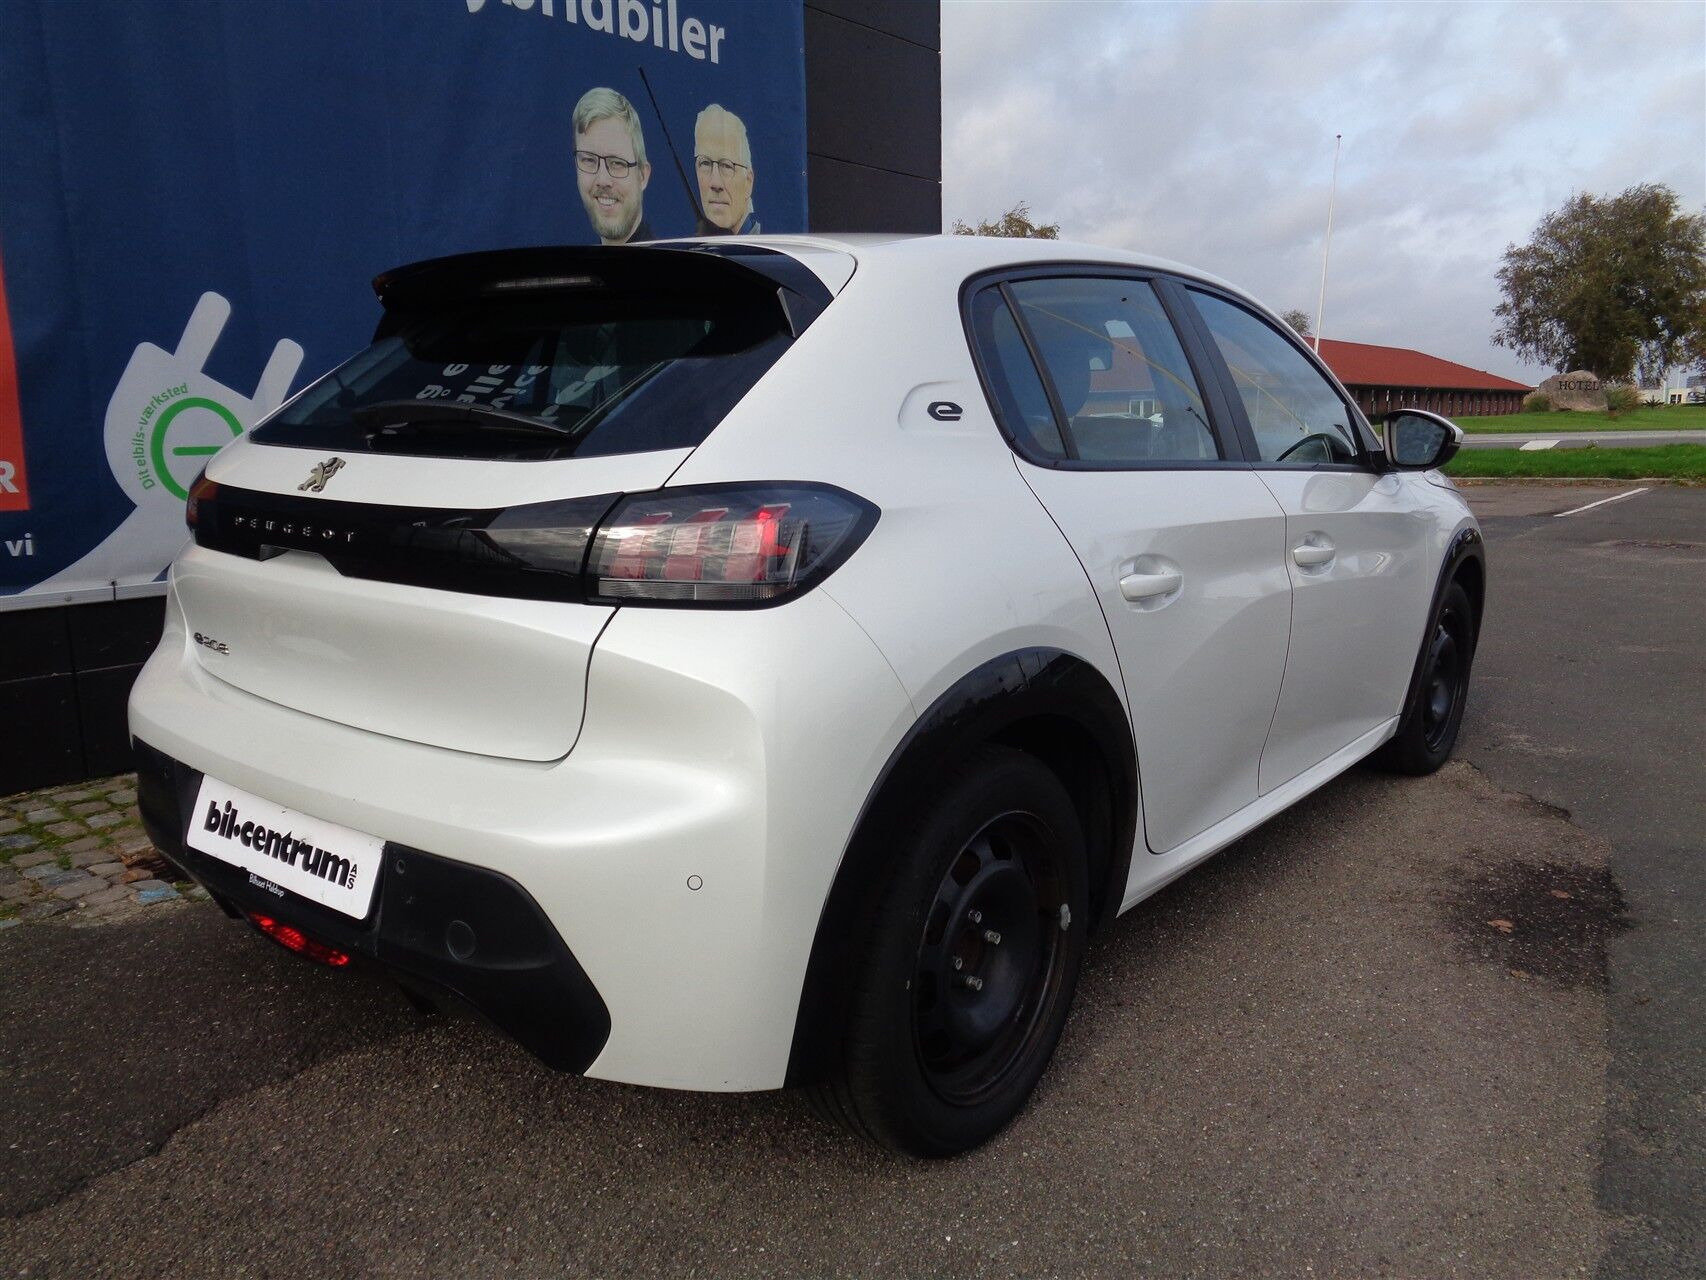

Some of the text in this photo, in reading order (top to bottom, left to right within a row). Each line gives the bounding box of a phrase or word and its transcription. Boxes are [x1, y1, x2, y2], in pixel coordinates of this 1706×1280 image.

[1558, 380, 1600, 391] HOTEL
[132, 383, 189, 490] Dit elbils-værksted
[5, 533, 33, 556] vi
